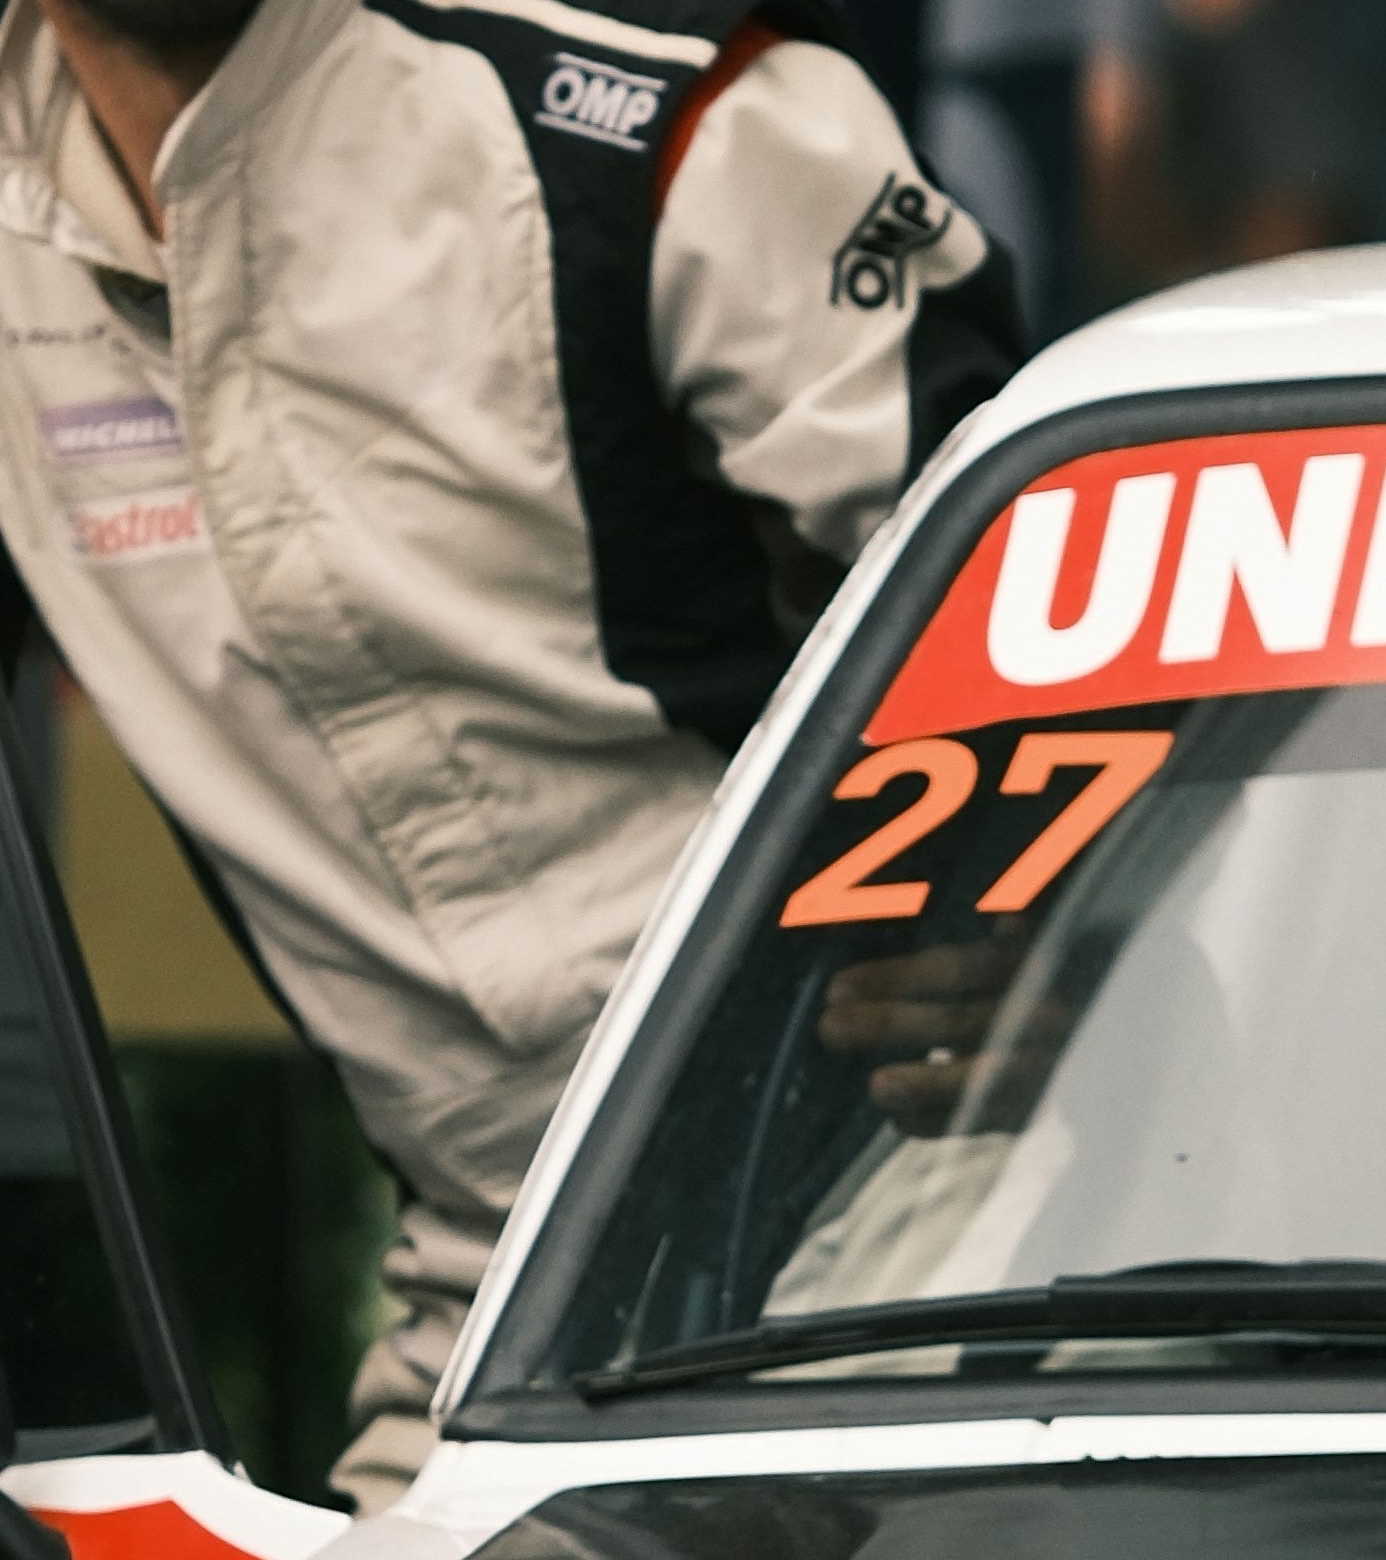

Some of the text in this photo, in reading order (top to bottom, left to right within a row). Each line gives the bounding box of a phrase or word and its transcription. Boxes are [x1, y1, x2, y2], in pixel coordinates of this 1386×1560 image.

[544, 68, 659, 136] OMP
[847, 185, 933, 308] OMP
[777, 729, 1175, 927] 27
